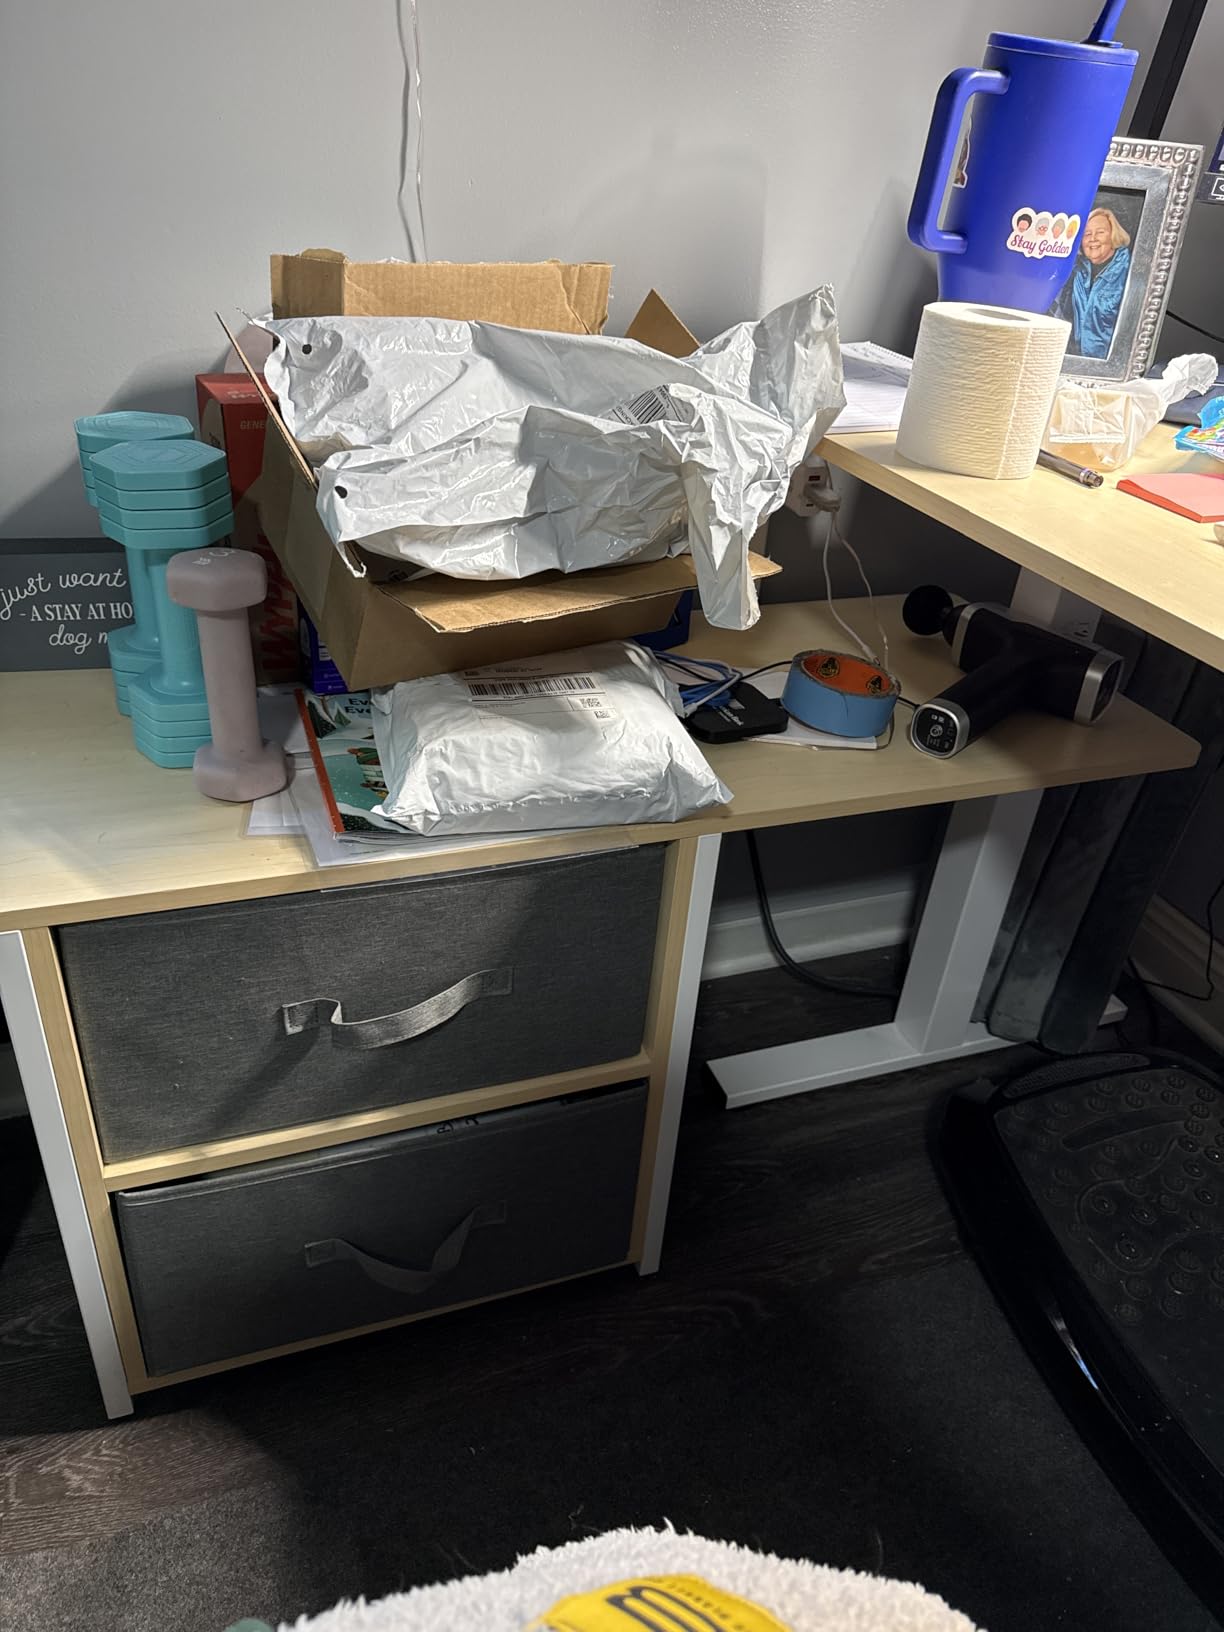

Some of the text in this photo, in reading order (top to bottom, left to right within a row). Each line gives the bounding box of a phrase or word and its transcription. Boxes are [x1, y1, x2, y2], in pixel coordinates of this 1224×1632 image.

[1010, 234, 1070, 256] Stay Golden
[0, 568, 127, 621] just want
[30, 604, 43, 622] A
[44, 603, 82, 621] STAY
[87, 602, 107, 620] AT
[48, 623, 93, 655] dog
